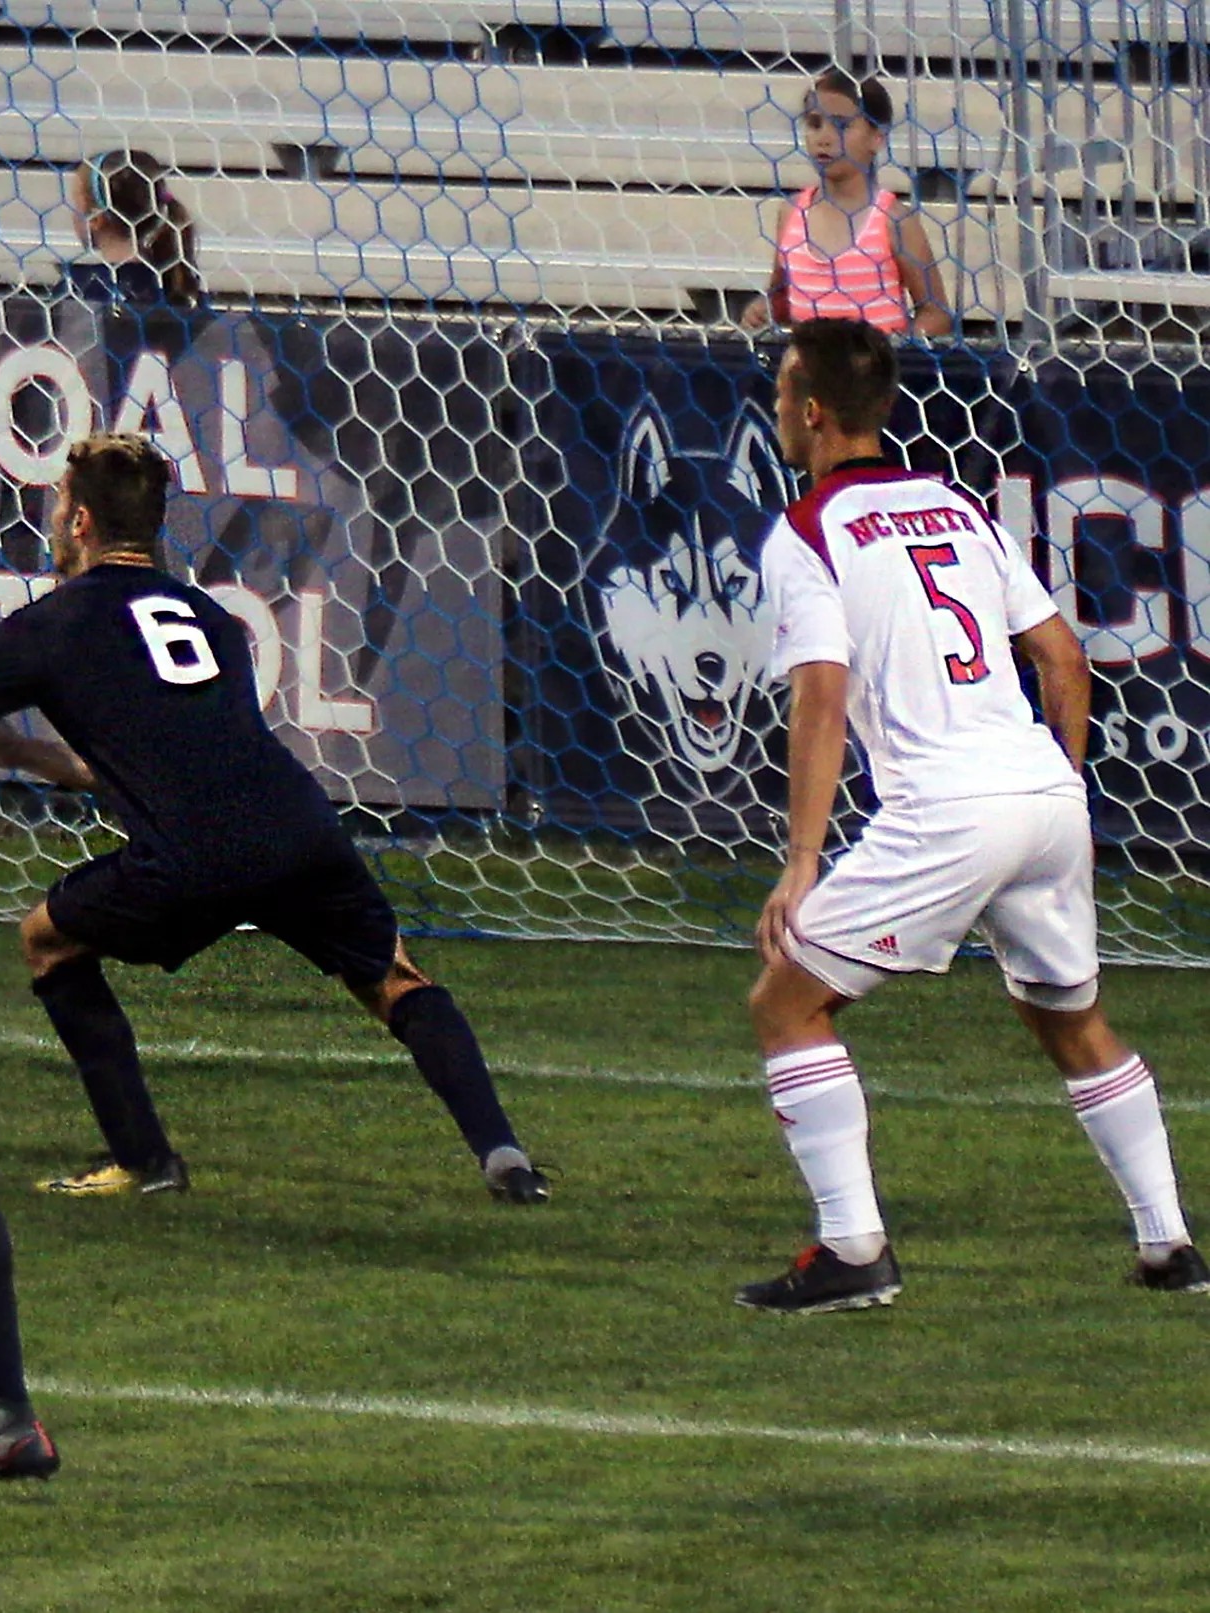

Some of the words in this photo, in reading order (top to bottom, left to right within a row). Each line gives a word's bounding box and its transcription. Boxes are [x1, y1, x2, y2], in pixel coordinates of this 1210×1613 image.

[128, 595, 221, 686] 6
[905, 541, 991, 685] 5
[1104, 710, 1210, 763] SO
